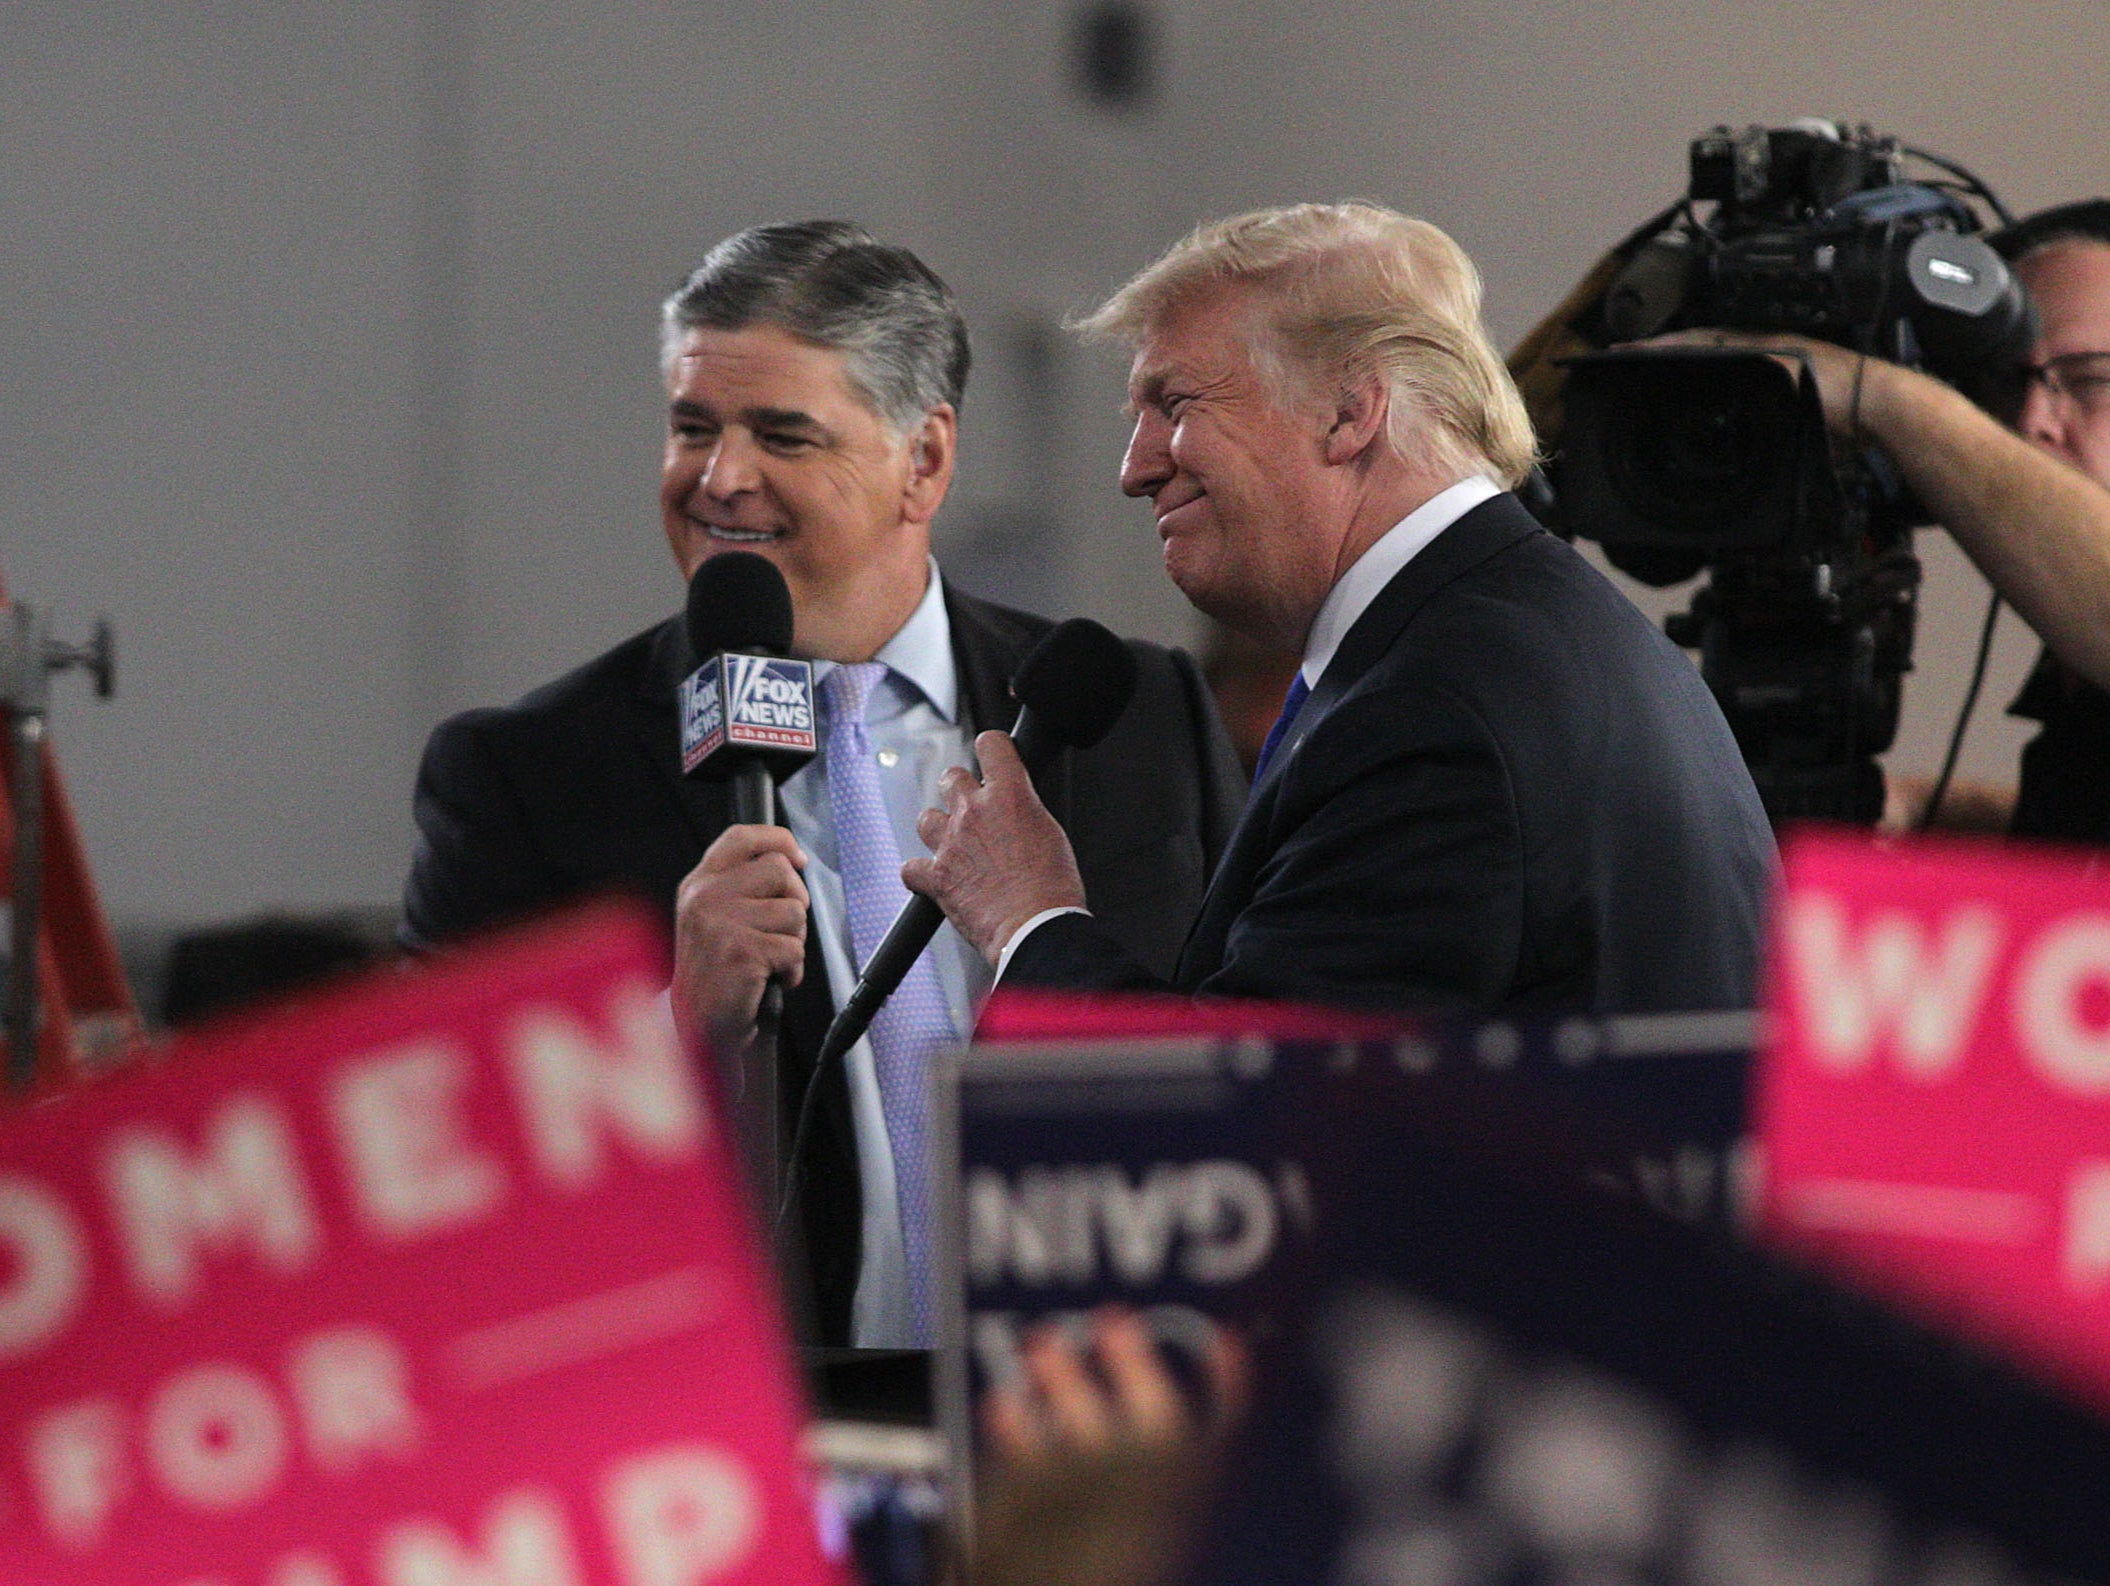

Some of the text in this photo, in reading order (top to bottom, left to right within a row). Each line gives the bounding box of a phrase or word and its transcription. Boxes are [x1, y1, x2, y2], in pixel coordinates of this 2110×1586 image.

[755, 678, 807, 705] FOX
[741, 701, 810, 729] NEWS
[733, 727, 811, 745] channel
[32, 1326, 416, 1544] FOR
